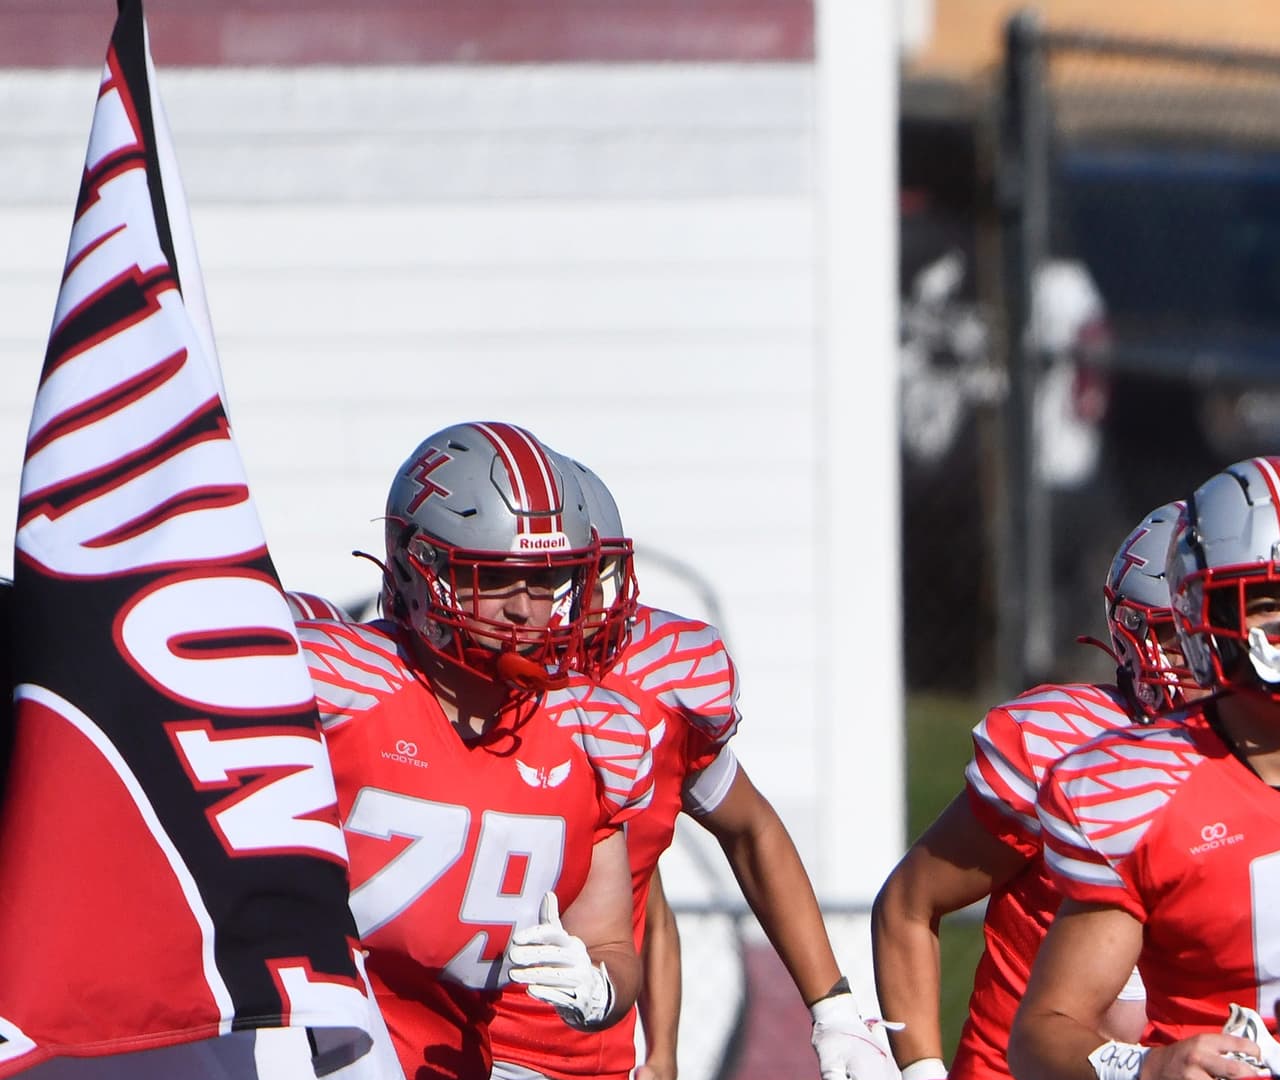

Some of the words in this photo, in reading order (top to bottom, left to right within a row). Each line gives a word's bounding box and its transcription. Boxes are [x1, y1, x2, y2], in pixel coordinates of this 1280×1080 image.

[519, 536, 566, 549] Riddell
[380, 751, 429, 769] WOOTER
[1189, 832, 1245, 856] WOOTER
[343, 786, 567, 991] 79
